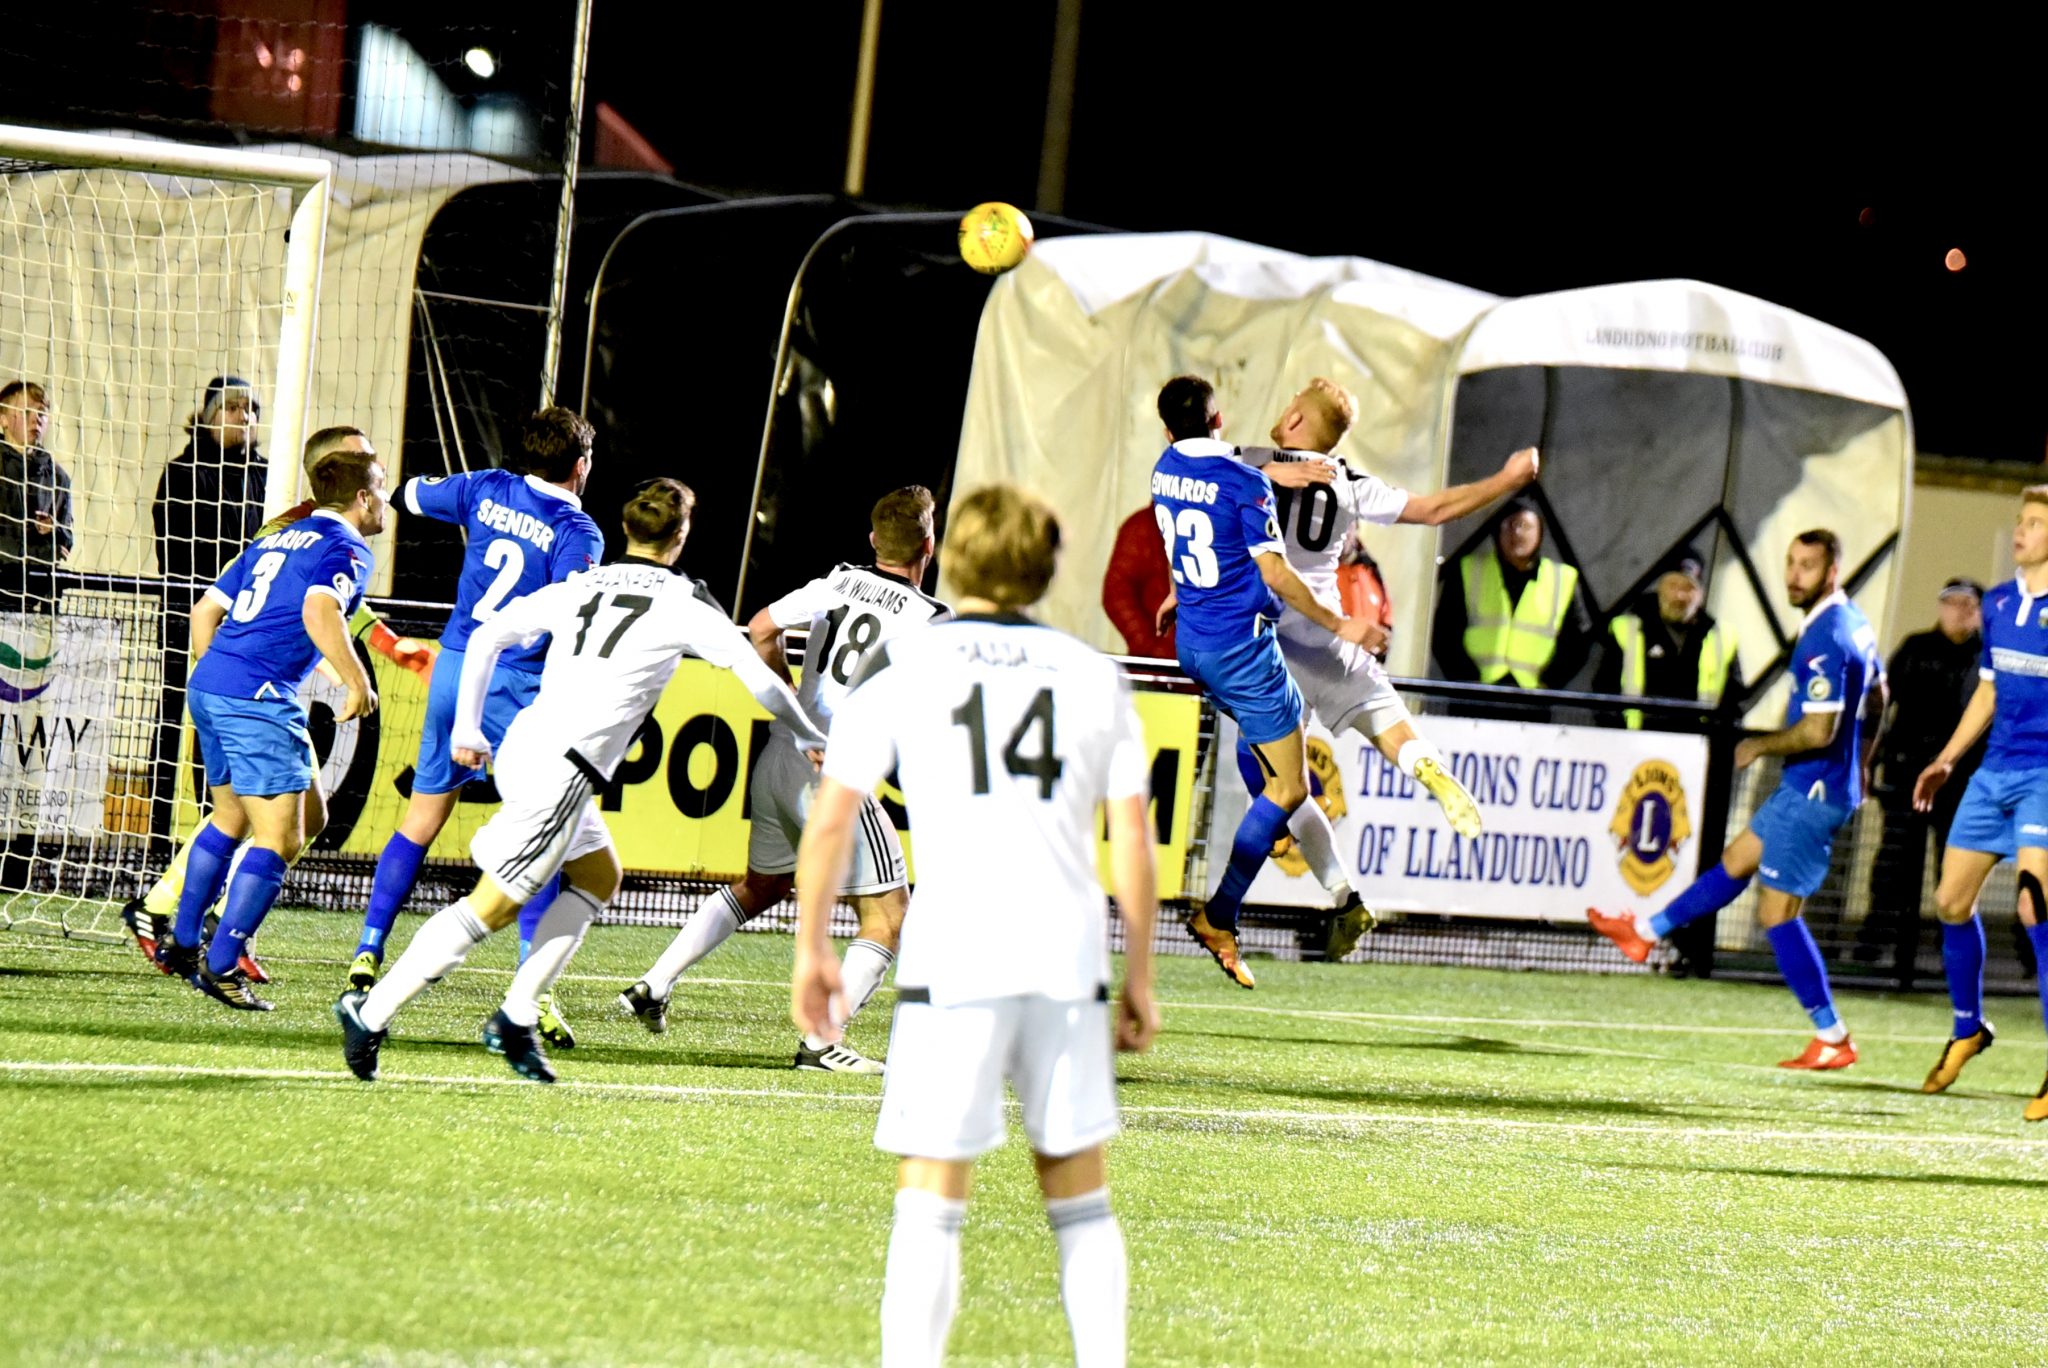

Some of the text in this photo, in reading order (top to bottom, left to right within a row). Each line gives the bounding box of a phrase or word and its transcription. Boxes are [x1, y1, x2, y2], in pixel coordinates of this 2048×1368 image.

[1152, 471, 1220, 505] EDWARDS
[1154, 503, 1220, 589] 23
[232, 551, 287, 623] 3
[471, 538, 524, 623] 2
[848, 578, 908, 615] WILLIAMS
[572, 590, 655, 659] 17
[816, 603, 882, 688] 18
[0, 713, 91, 772] WY
[951, 682, 1066, 802] 14
[1427, 751, 1520, 806] IONS
[1530, 757, 1607, 811] CLUB
[1357, 823, 1590, 889] OF LLANDUDNO
[1637, 799, 1660, 852] L
